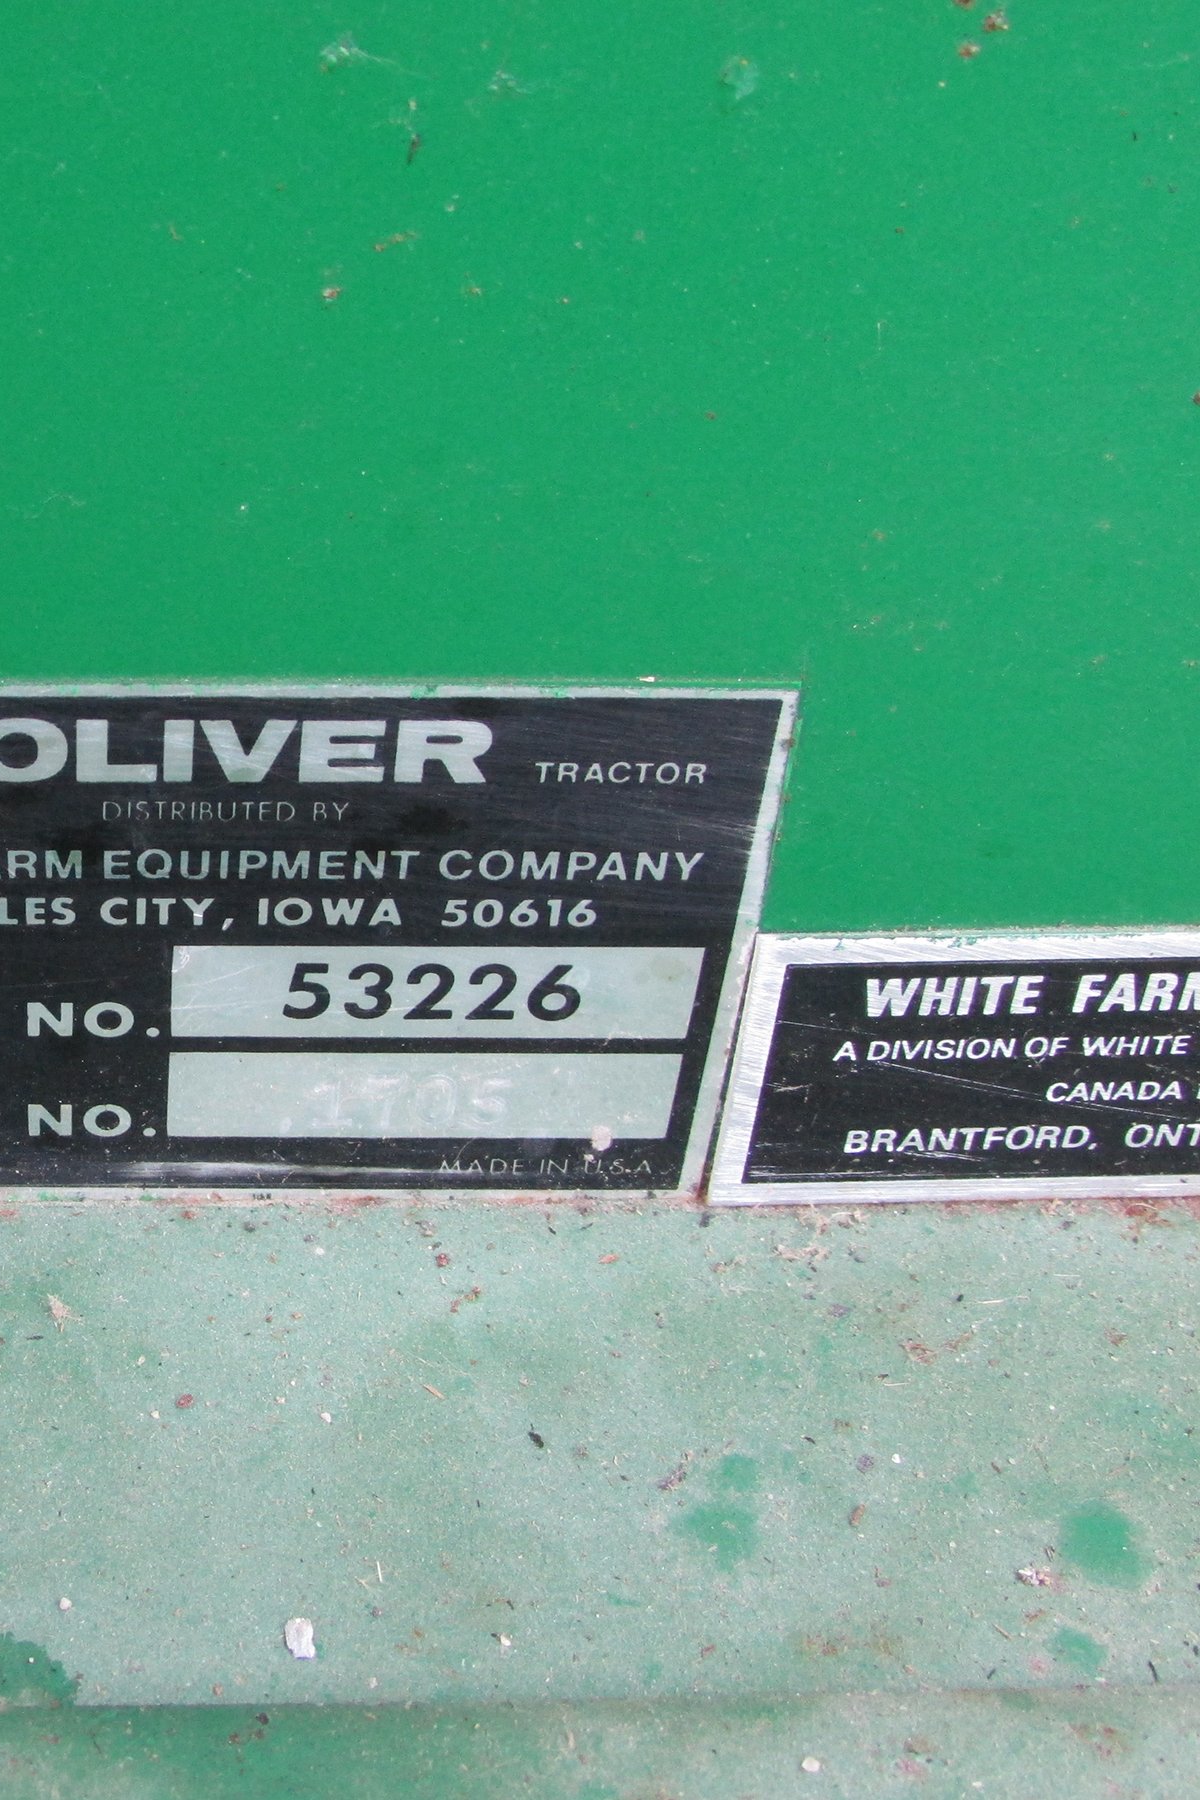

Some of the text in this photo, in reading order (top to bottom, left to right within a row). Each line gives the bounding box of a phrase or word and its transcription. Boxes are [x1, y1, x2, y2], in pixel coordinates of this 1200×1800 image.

[535, 762, 708, 784] TRACTOR
[102, 801, 349, 822] DISTRIBUTED BY
[103, 849, 420, 880] EQUIPMENT
[439, 850, 705, 881] COMPANY
[100, 897, 235, 931] CITY,
[257, 897, 402, 927] IOWA
[441, 899, 597, 928] 50616
[27, 1001, 160, 1038] NO.
[282, 962, 582, 1021] 53226
[866, 975, 1045, 1017] WHITE
[833, 1035, 1192, 1062] A DIVISION OF WHITE
[1045, 1081, 1183, 1102] CANADA
[27, 1103, 156, 1137] NO.
[844, 1125, 1098, 1153] BRANTFORD,
[439, 1158, 525, 1175] MADE
[540, 1159, 568, 1174] IN
